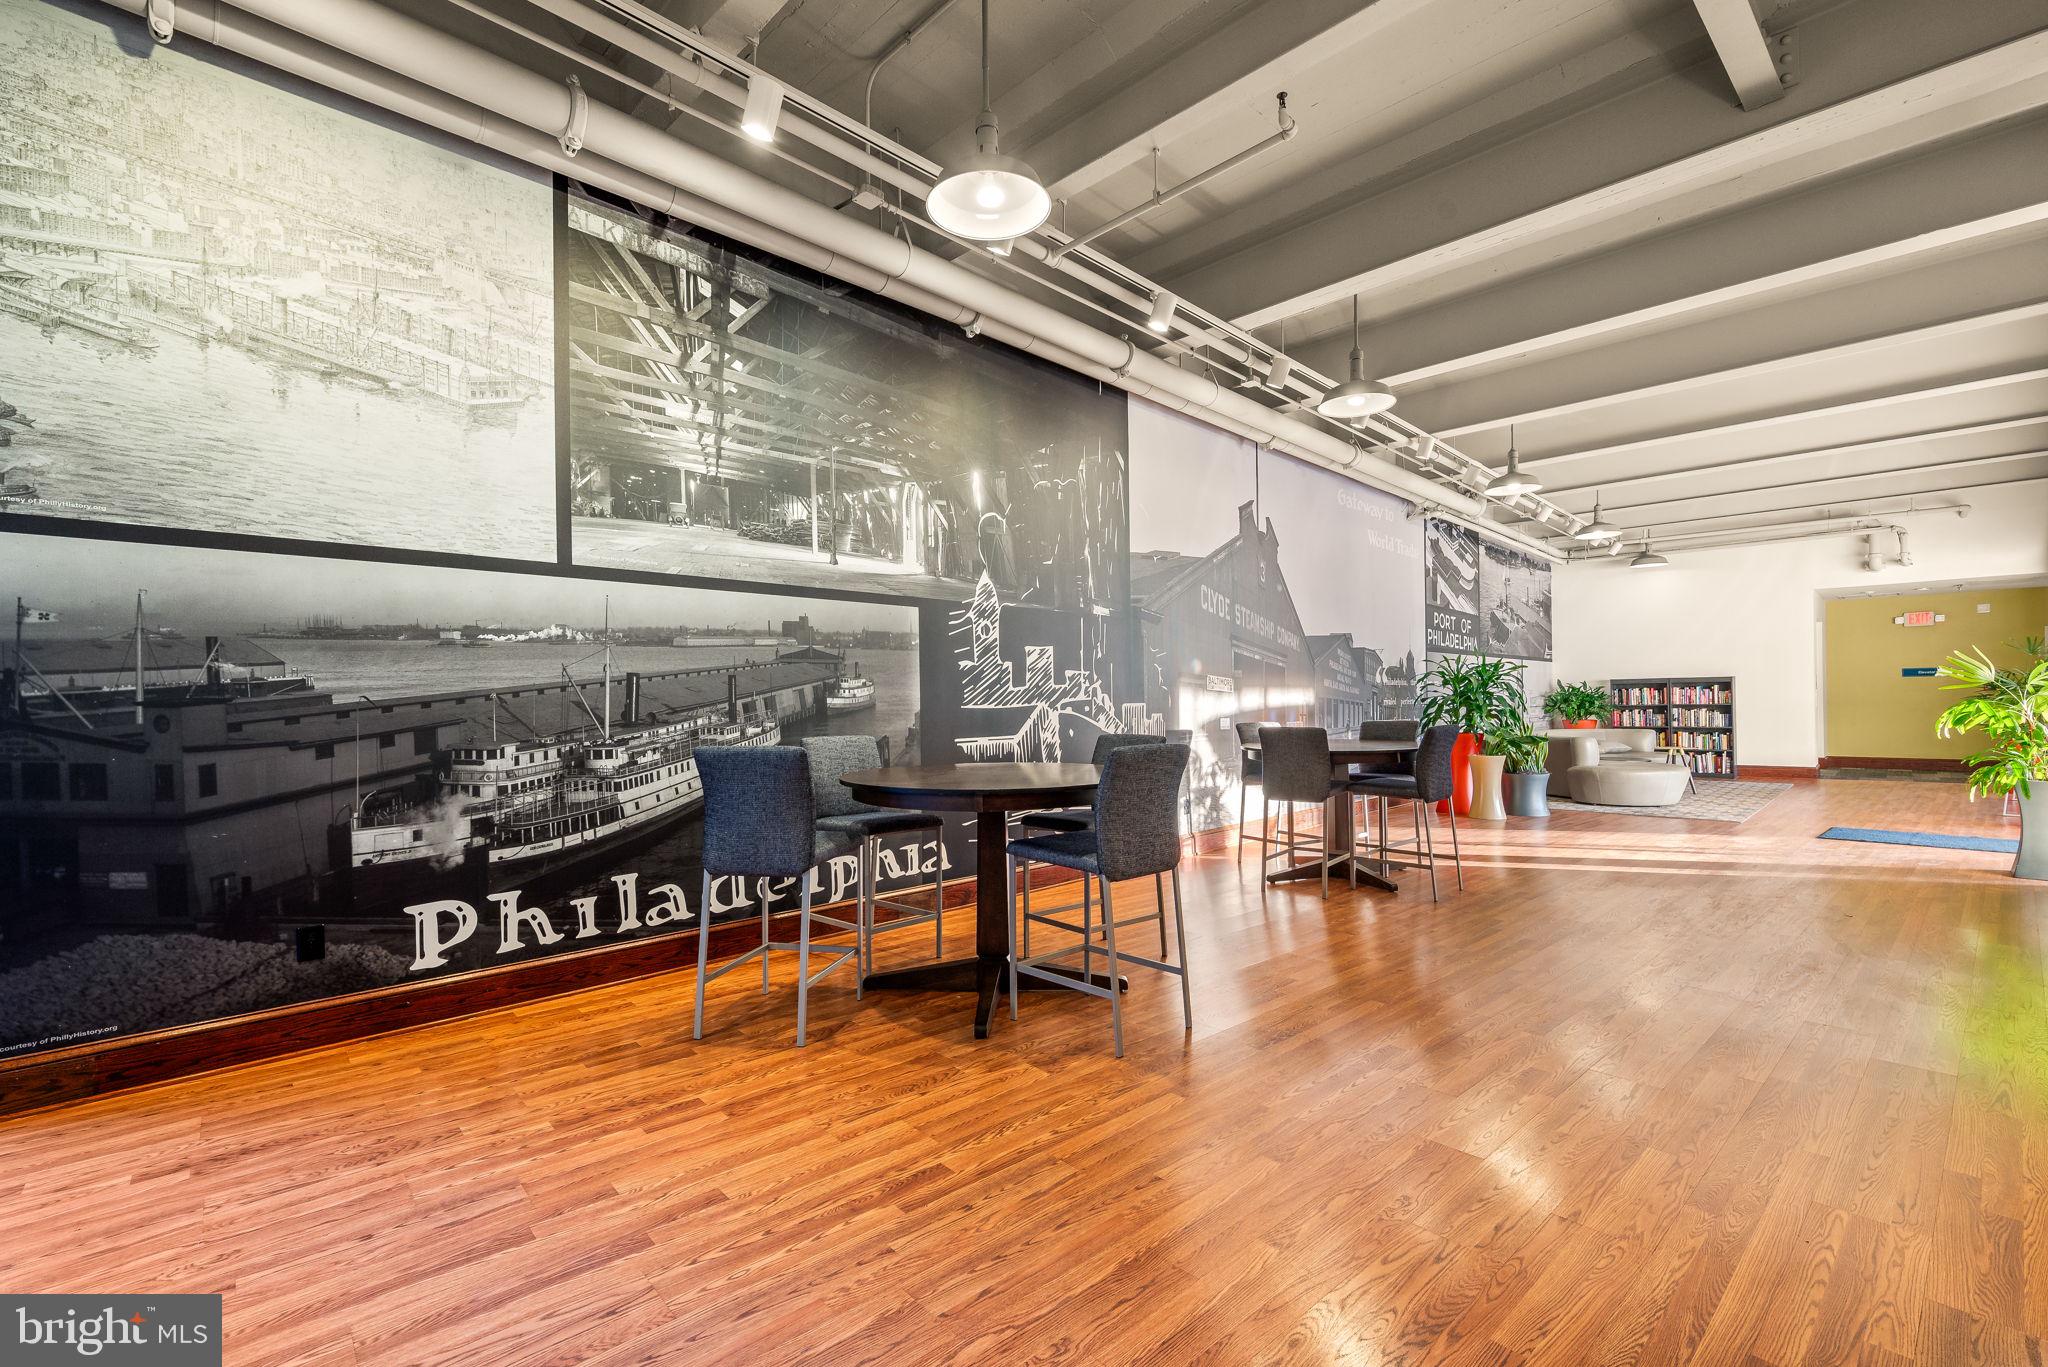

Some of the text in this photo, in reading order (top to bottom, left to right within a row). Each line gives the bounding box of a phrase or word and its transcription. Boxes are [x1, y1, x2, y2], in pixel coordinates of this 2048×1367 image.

[40, 499, 107, 511] PhillyHistory.org
[1337, 488, 1394, 521] Gateway to
[1368, 528, 1395, 552] World
[1201, 584, 1231, 621] CLYDE
[1235, 603, 1275, 640] STEAMSHIP
[1433, 612, 1472, 633] PORT OF
[1908, 613, 1930, 624] EXIT
[1428, 629, 1478, 652] PHILADELPHIA
[0, 1041, 37, 1053] courtesy
[50, 1025, 118, 1042] PhillyHistory.org
